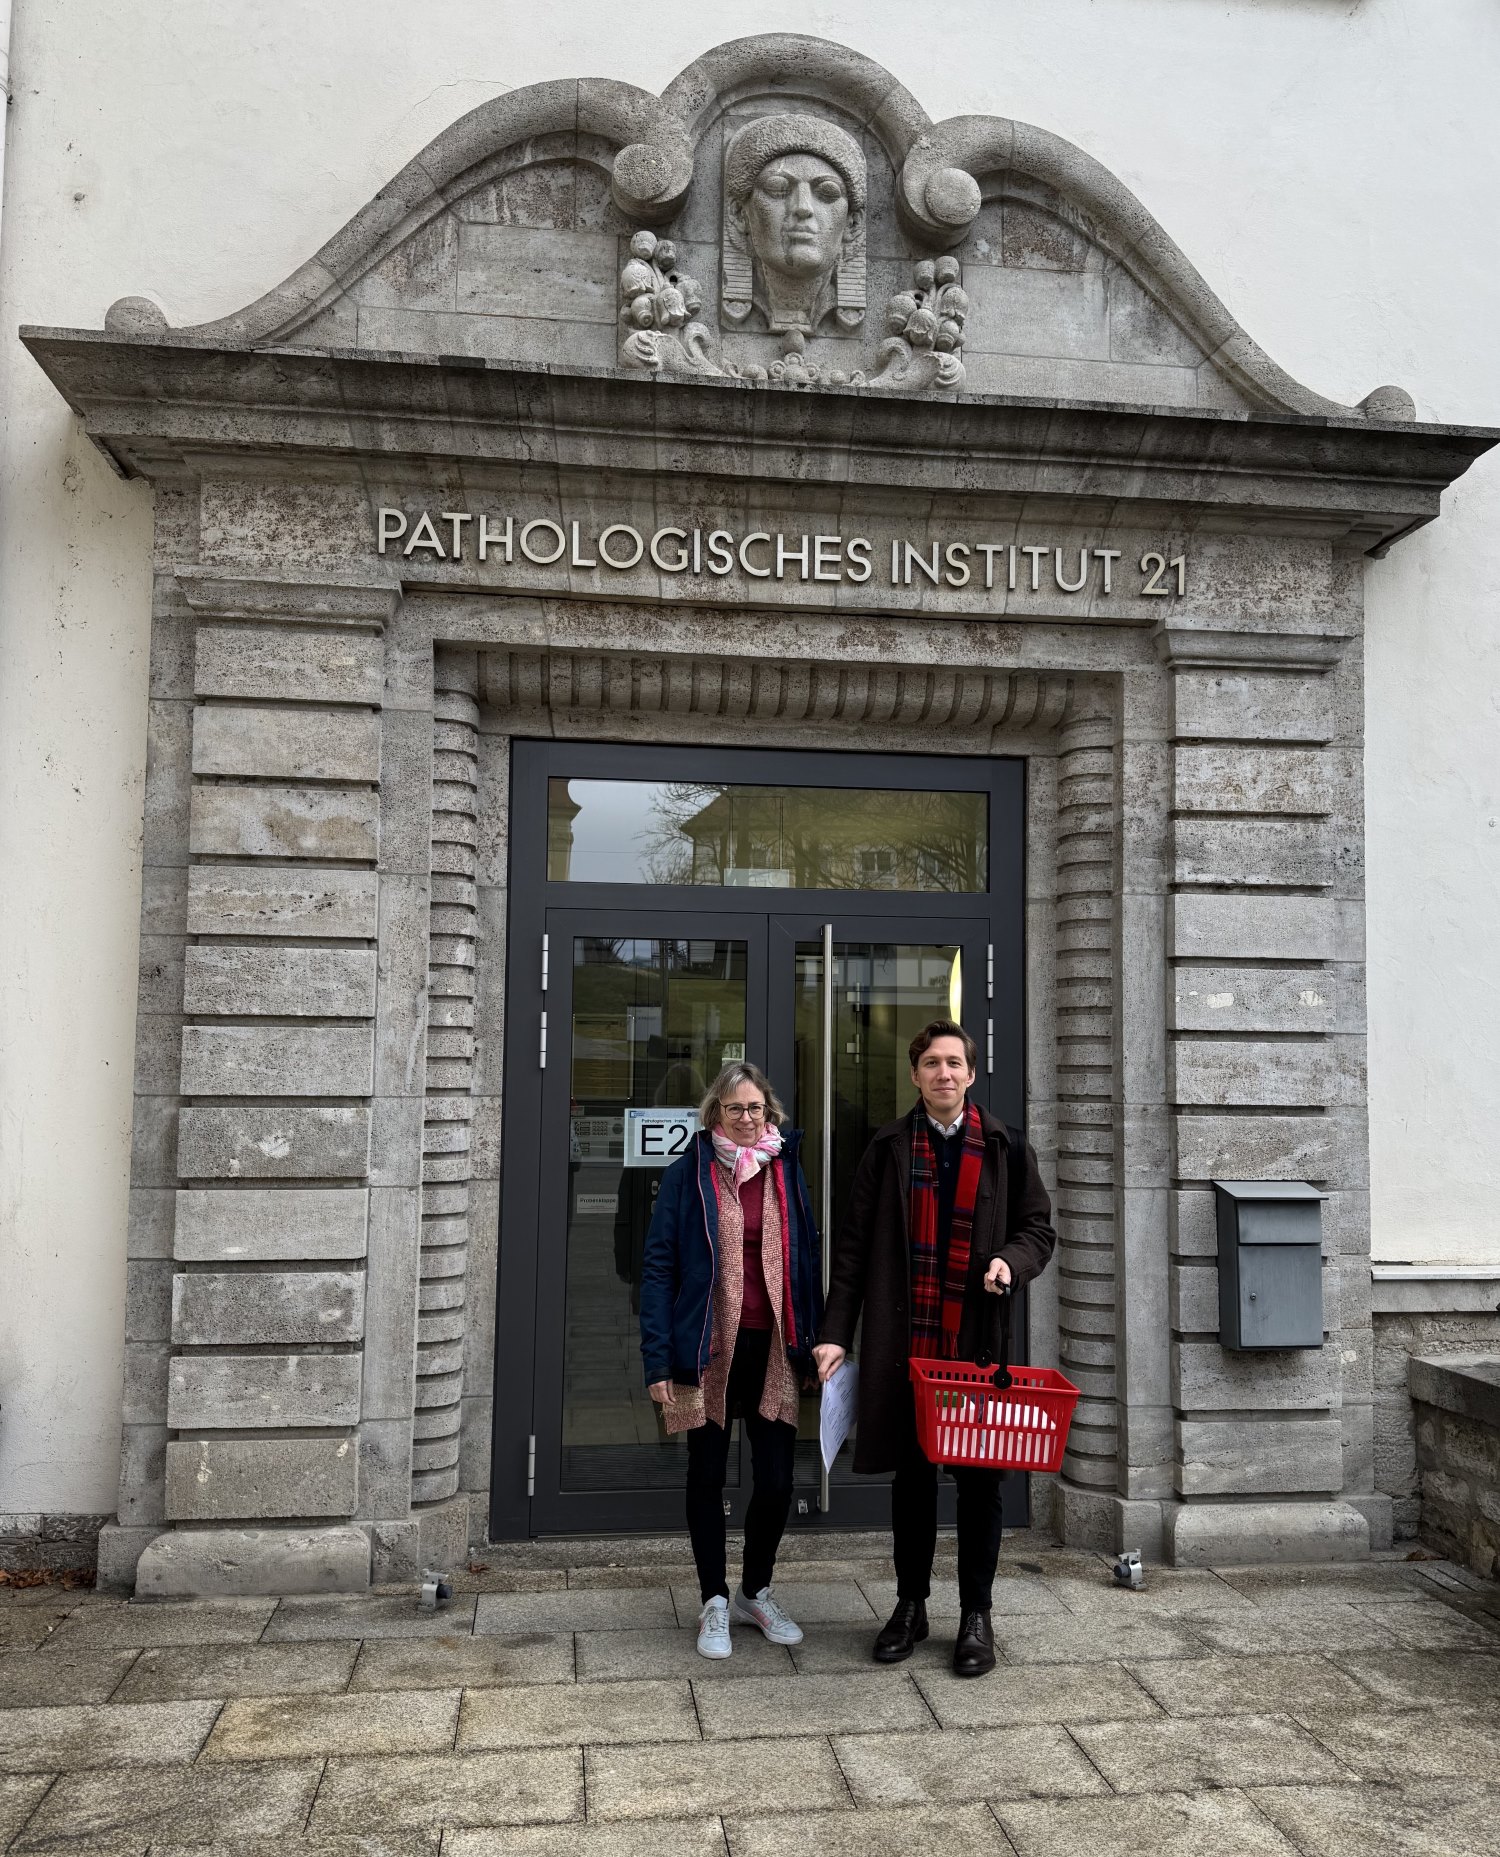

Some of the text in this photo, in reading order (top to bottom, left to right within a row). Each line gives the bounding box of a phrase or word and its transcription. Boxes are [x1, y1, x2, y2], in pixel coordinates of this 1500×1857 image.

[377, 507, 1186, 596] PATHOLOGISCHES INSTITUT 21
[641, 1124, 689, 1156] E2
